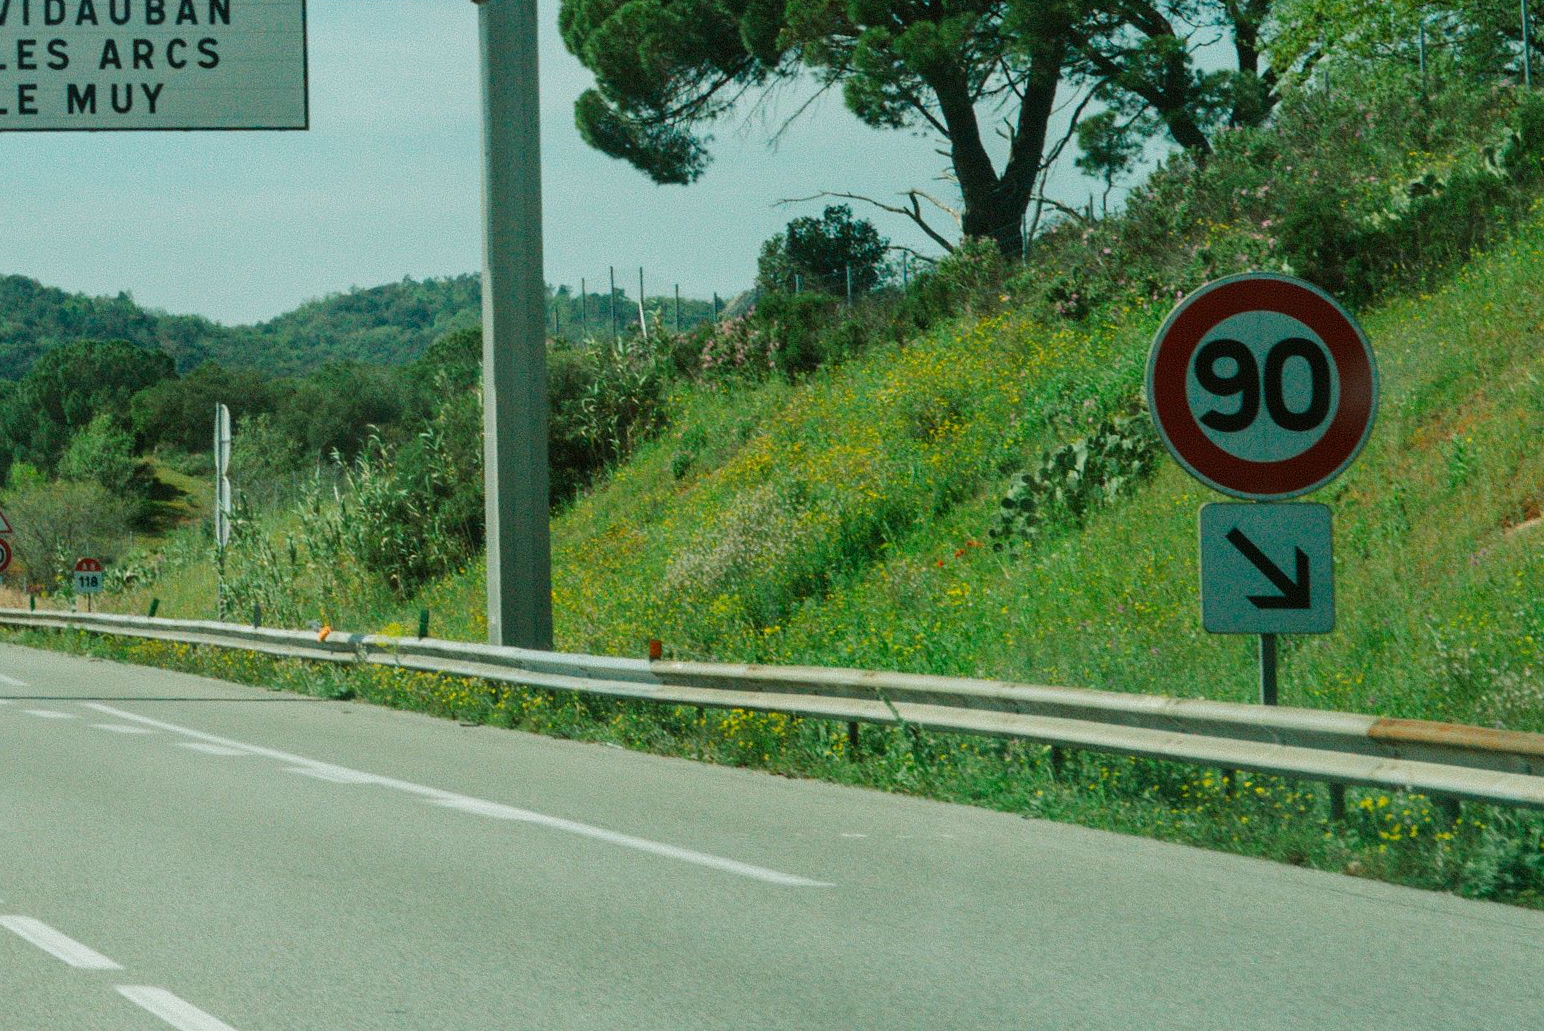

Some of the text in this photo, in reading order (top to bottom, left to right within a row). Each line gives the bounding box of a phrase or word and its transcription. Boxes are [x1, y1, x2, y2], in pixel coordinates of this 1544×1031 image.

[99, 37, 220, 70] ARCS
[67, 82, 164, 115] MUY
[1193, 336, 1332, 433] 90
[78, 575, 99, 588] 118
